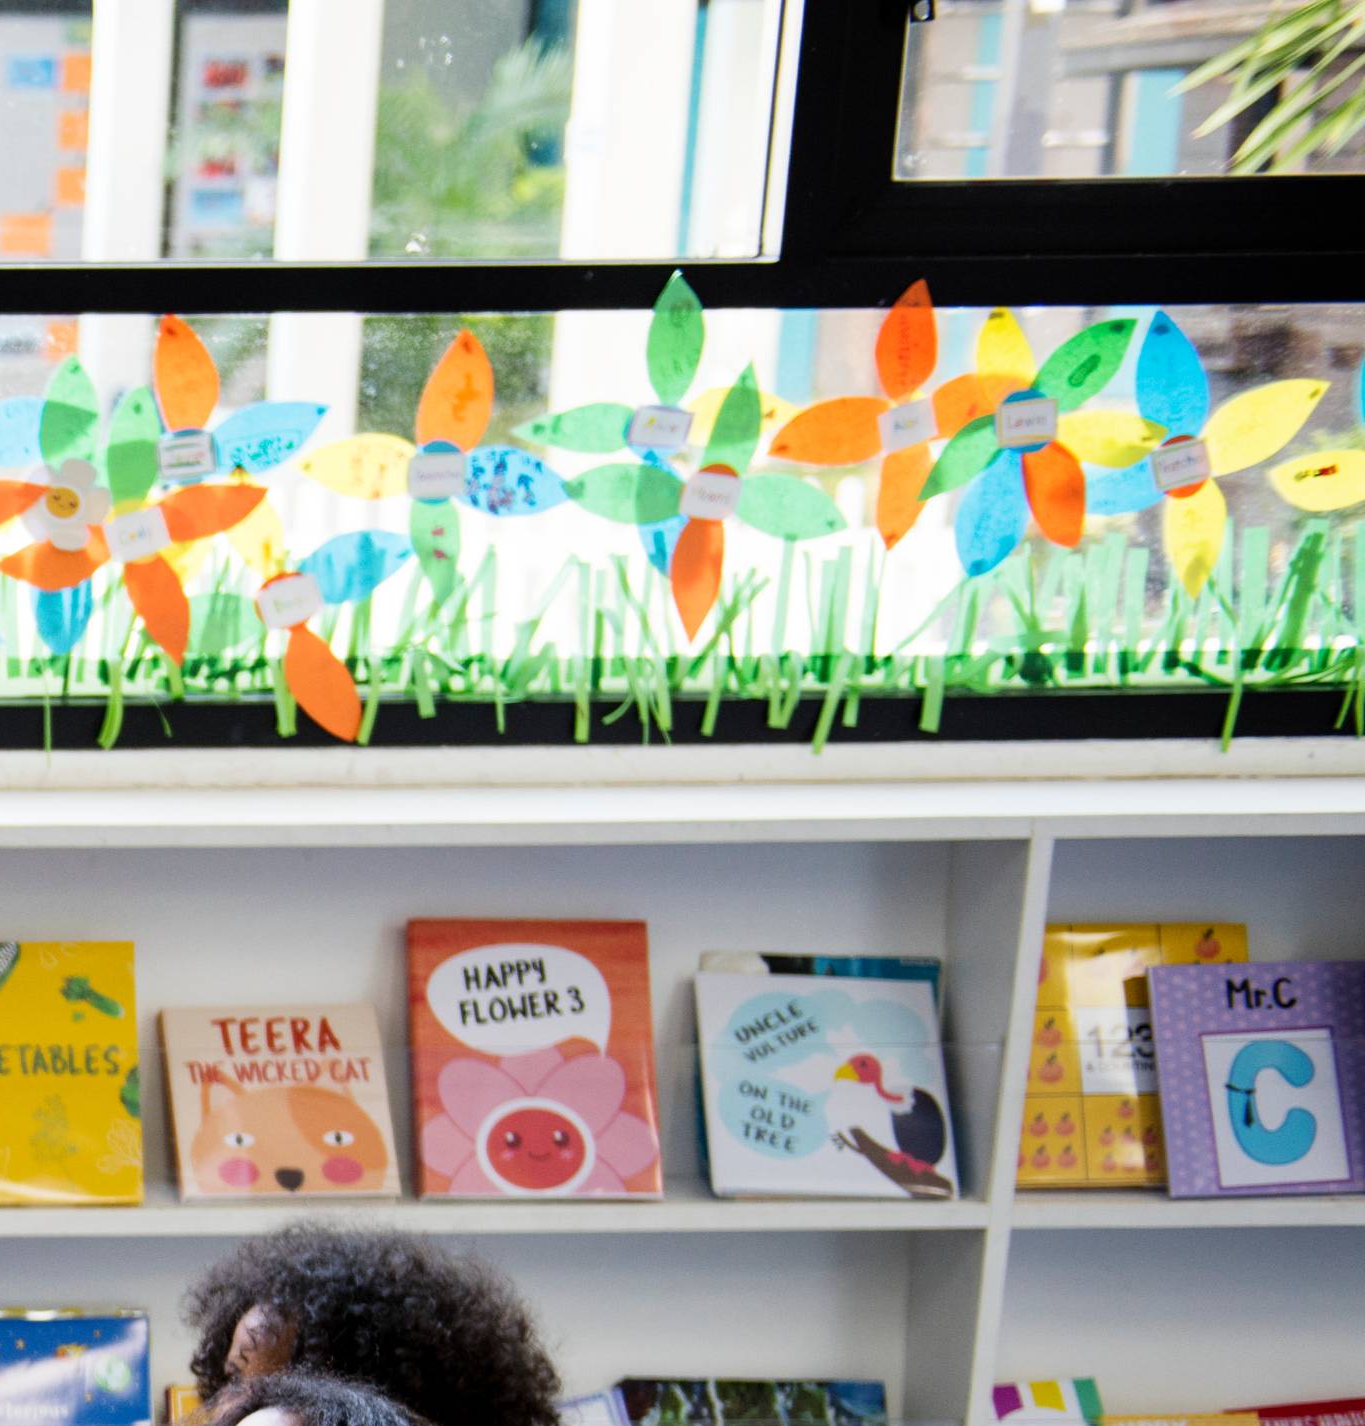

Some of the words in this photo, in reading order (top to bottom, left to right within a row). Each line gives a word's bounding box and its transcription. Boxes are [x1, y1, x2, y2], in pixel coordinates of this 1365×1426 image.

[462, 957, 548, 992] HAPPY
[459, 990, 563, 1026] FLOWER
[567, 988, 585, 1014] 3
[734, 999, 803, 1043] UNCLE
[212, 1016, 342, 1057] TEERA
[744, 1016, 818, 1062] VULTURE
[185, 1060, 224, 1084] THE
[234, 1058, 320, 1084] WICKED
[329, 1058, 373, 1083] CAT
[738, 1080, 767, 1100] ON
[779, 1091, 812, 1114] THE
[750, 1104, 796, 1130] OLD
[743, 1120, 797, 1152] TREE
